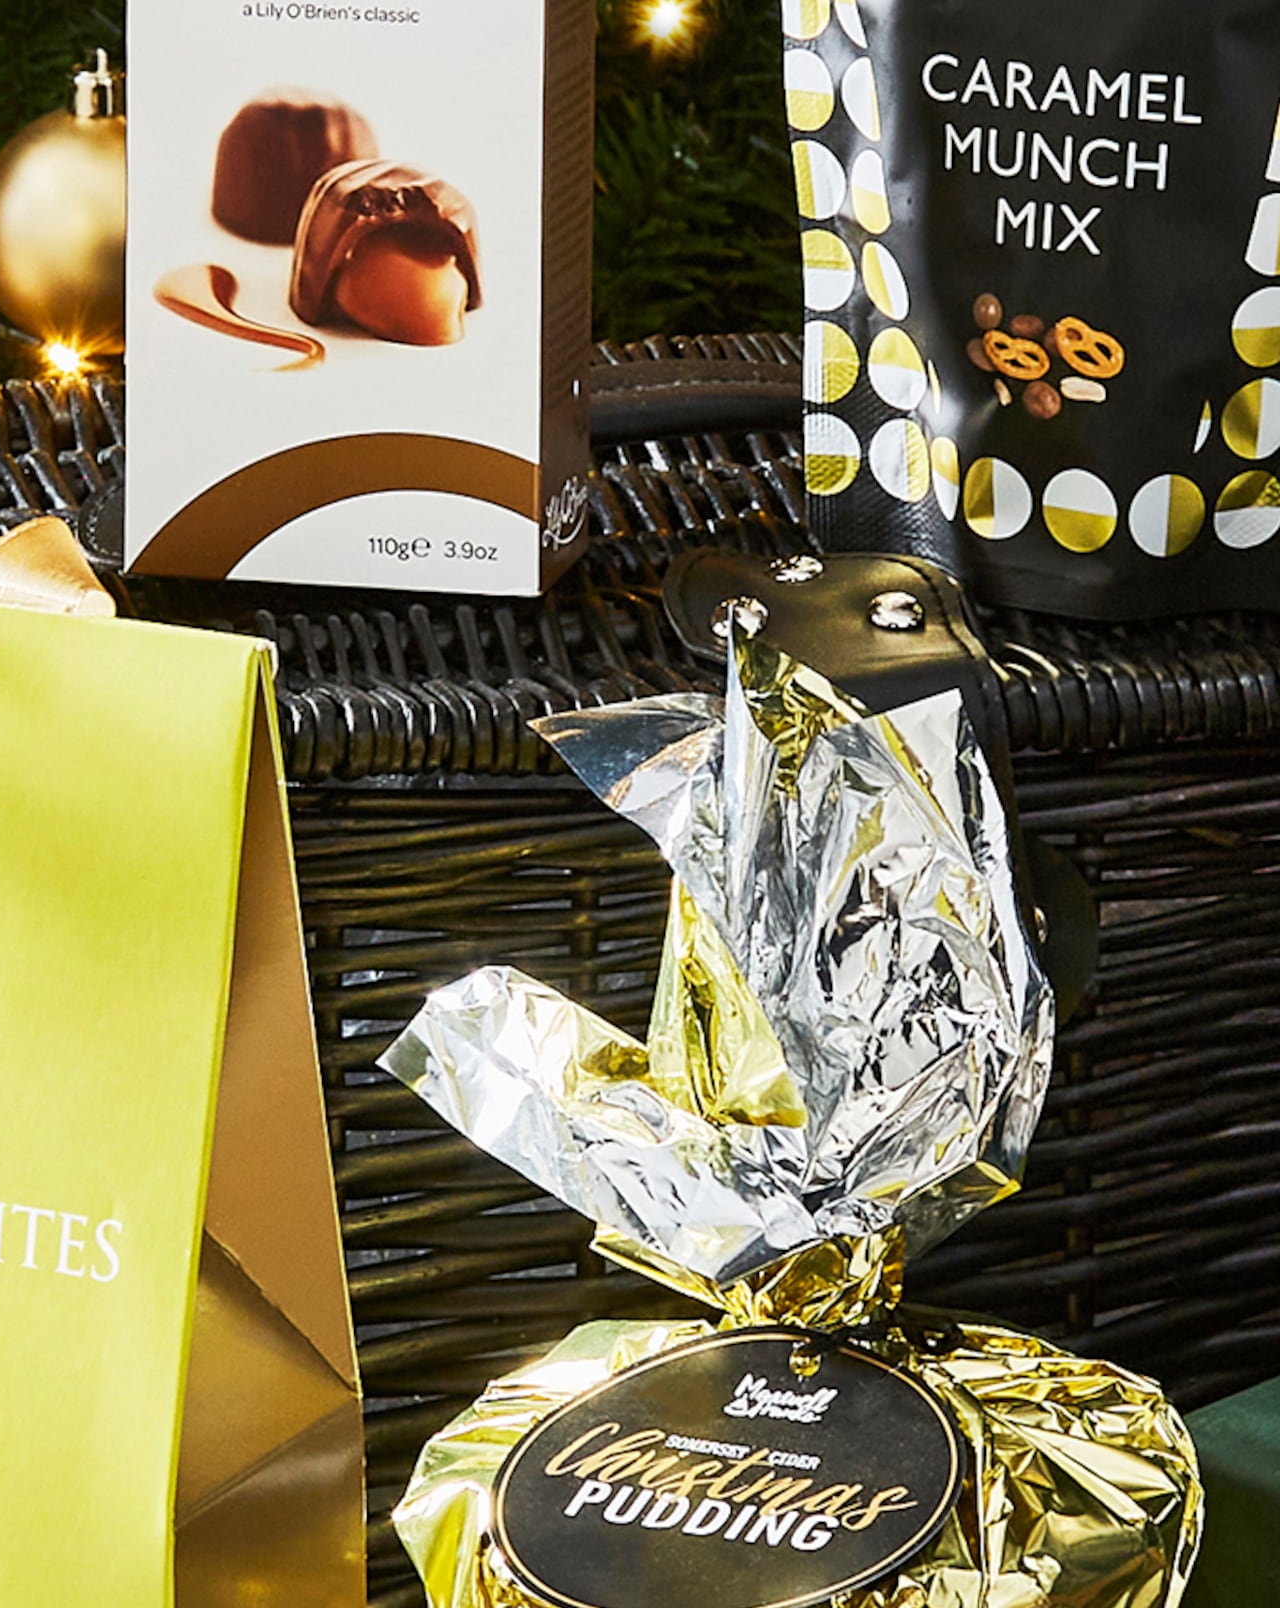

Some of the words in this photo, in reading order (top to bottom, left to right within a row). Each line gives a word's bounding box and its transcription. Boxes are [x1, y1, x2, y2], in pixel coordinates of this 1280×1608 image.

[242, 4, 253, 18] a
[256, 2, 284, 21] Lily
[287, 3, 361, 22] O'Brien's
[364, 5, 421, 24] classic
[921, 53, 1203, 125] CARAMEL
[944, 123, 1169, 191] MUNCH
[995, 197, 1102, 256] MIX
[444, 540, 498, 561] 3.9oz
[544, 1421, 919, 1531] Christmas
[664, 1434, 752, 1460] SOMERSET
[768, 1451, 822, 1471] CIDER
[563, 1479, 840, 1552] PUDDING
